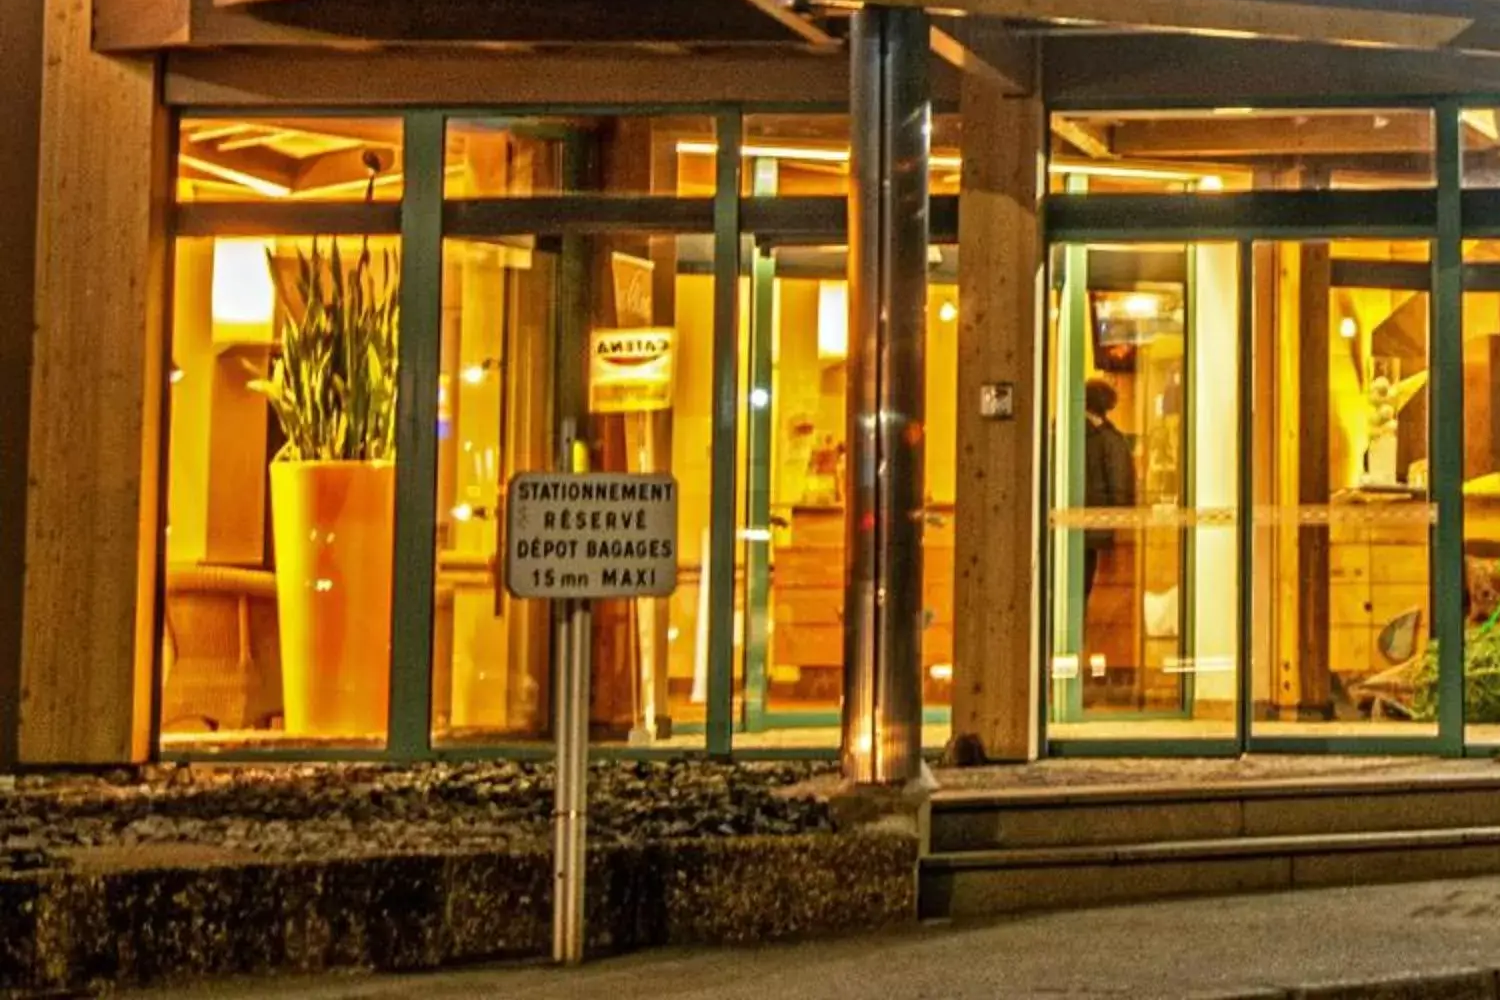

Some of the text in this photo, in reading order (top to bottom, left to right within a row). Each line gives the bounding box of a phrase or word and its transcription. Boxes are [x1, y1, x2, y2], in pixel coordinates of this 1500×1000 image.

[518, 481, 672, 500] STATIONNEMENT
[543, 509, 647, 530] RÉSERVÉ
[516, 537, 672, 559] DÉPOT BAGAGES
[533, 568, 656, 587] 15 mn MAXI
